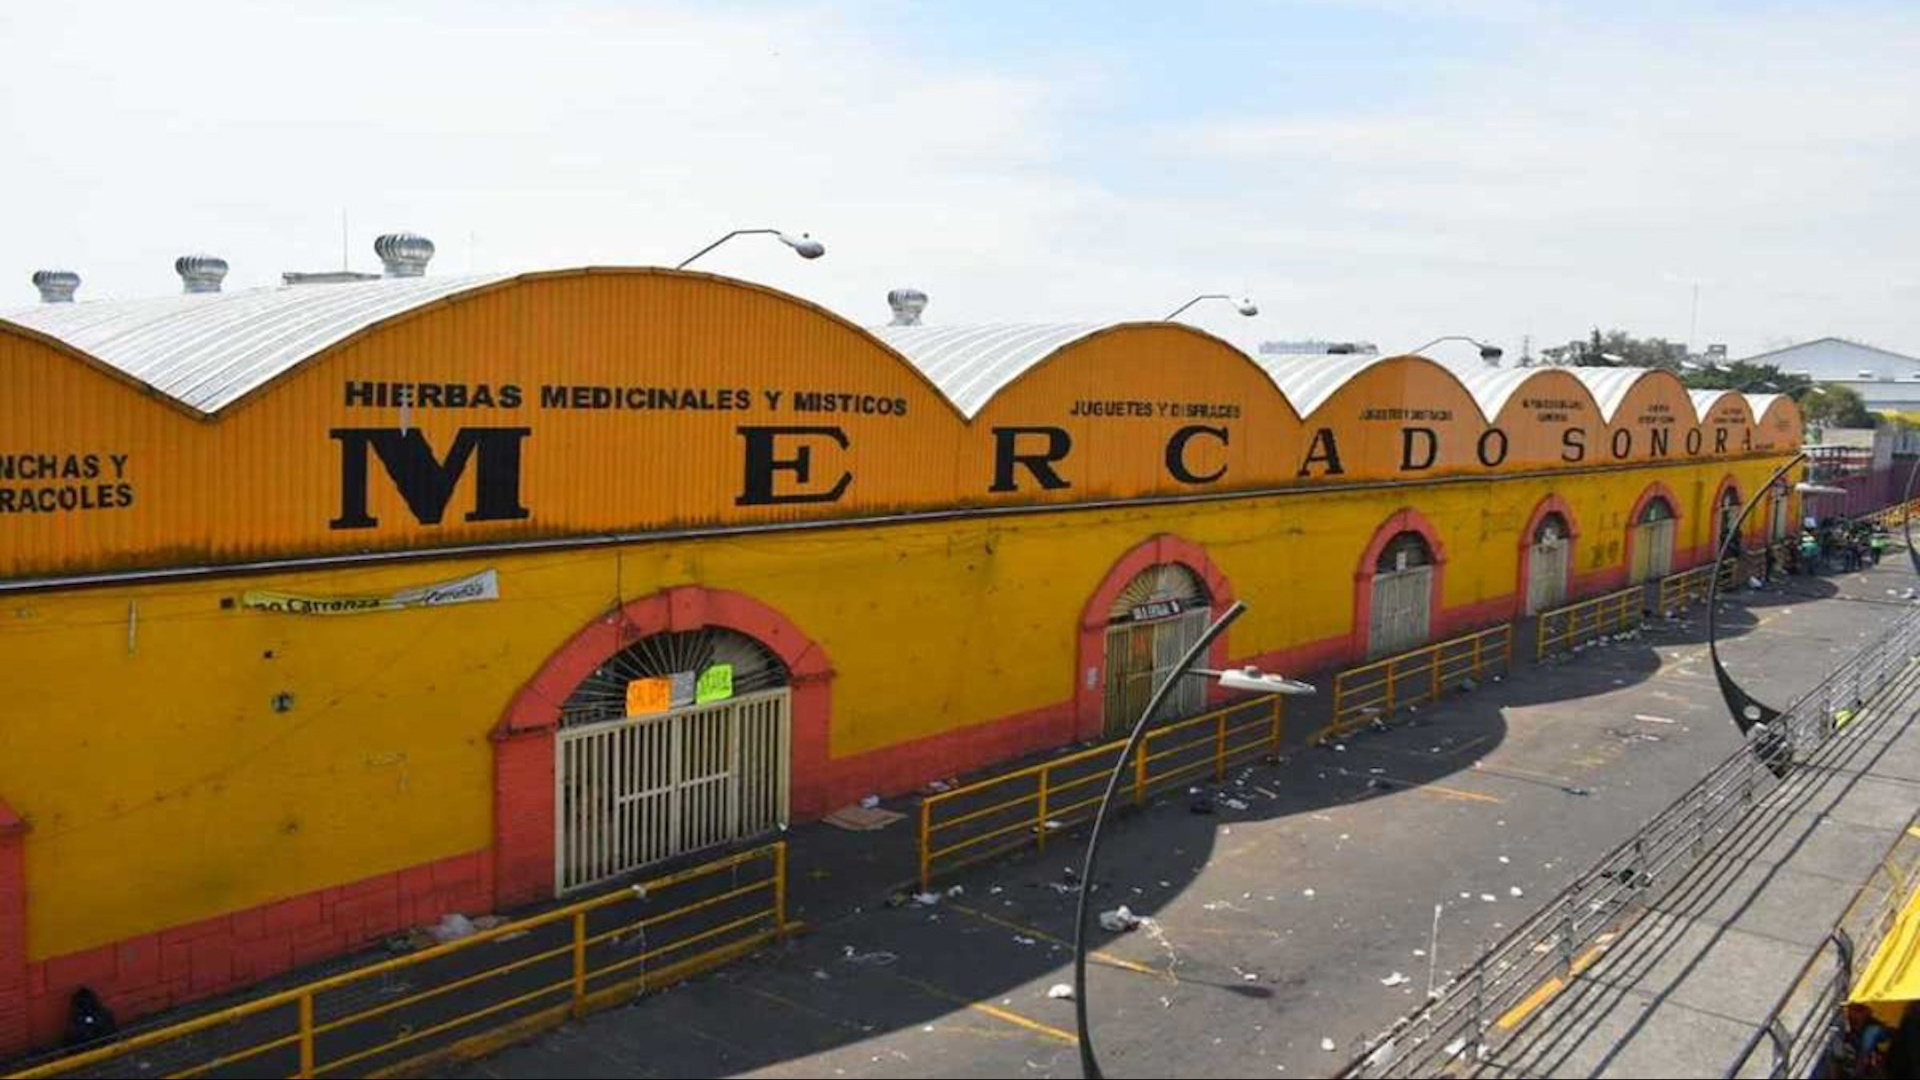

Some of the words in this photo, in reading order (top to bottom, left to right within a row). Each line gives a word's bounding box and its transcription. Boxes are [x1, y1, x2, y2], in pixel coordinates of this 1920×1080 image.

[345, 381, 522, 408] HIERBAS
[541, 385, 751, 411] MEDICINALES
[764, 390, 782, 411] Y
[793, 392, 907, 416] MISTICOS
[1070, 401, 1153, 417] JUGUETES
[1157, 403, 1169, 418] Y
[1561, 426, 1752, 463] SONORA
[108, 454, 128, 479] Y
[0, 484, 132, 512] RACOLES
